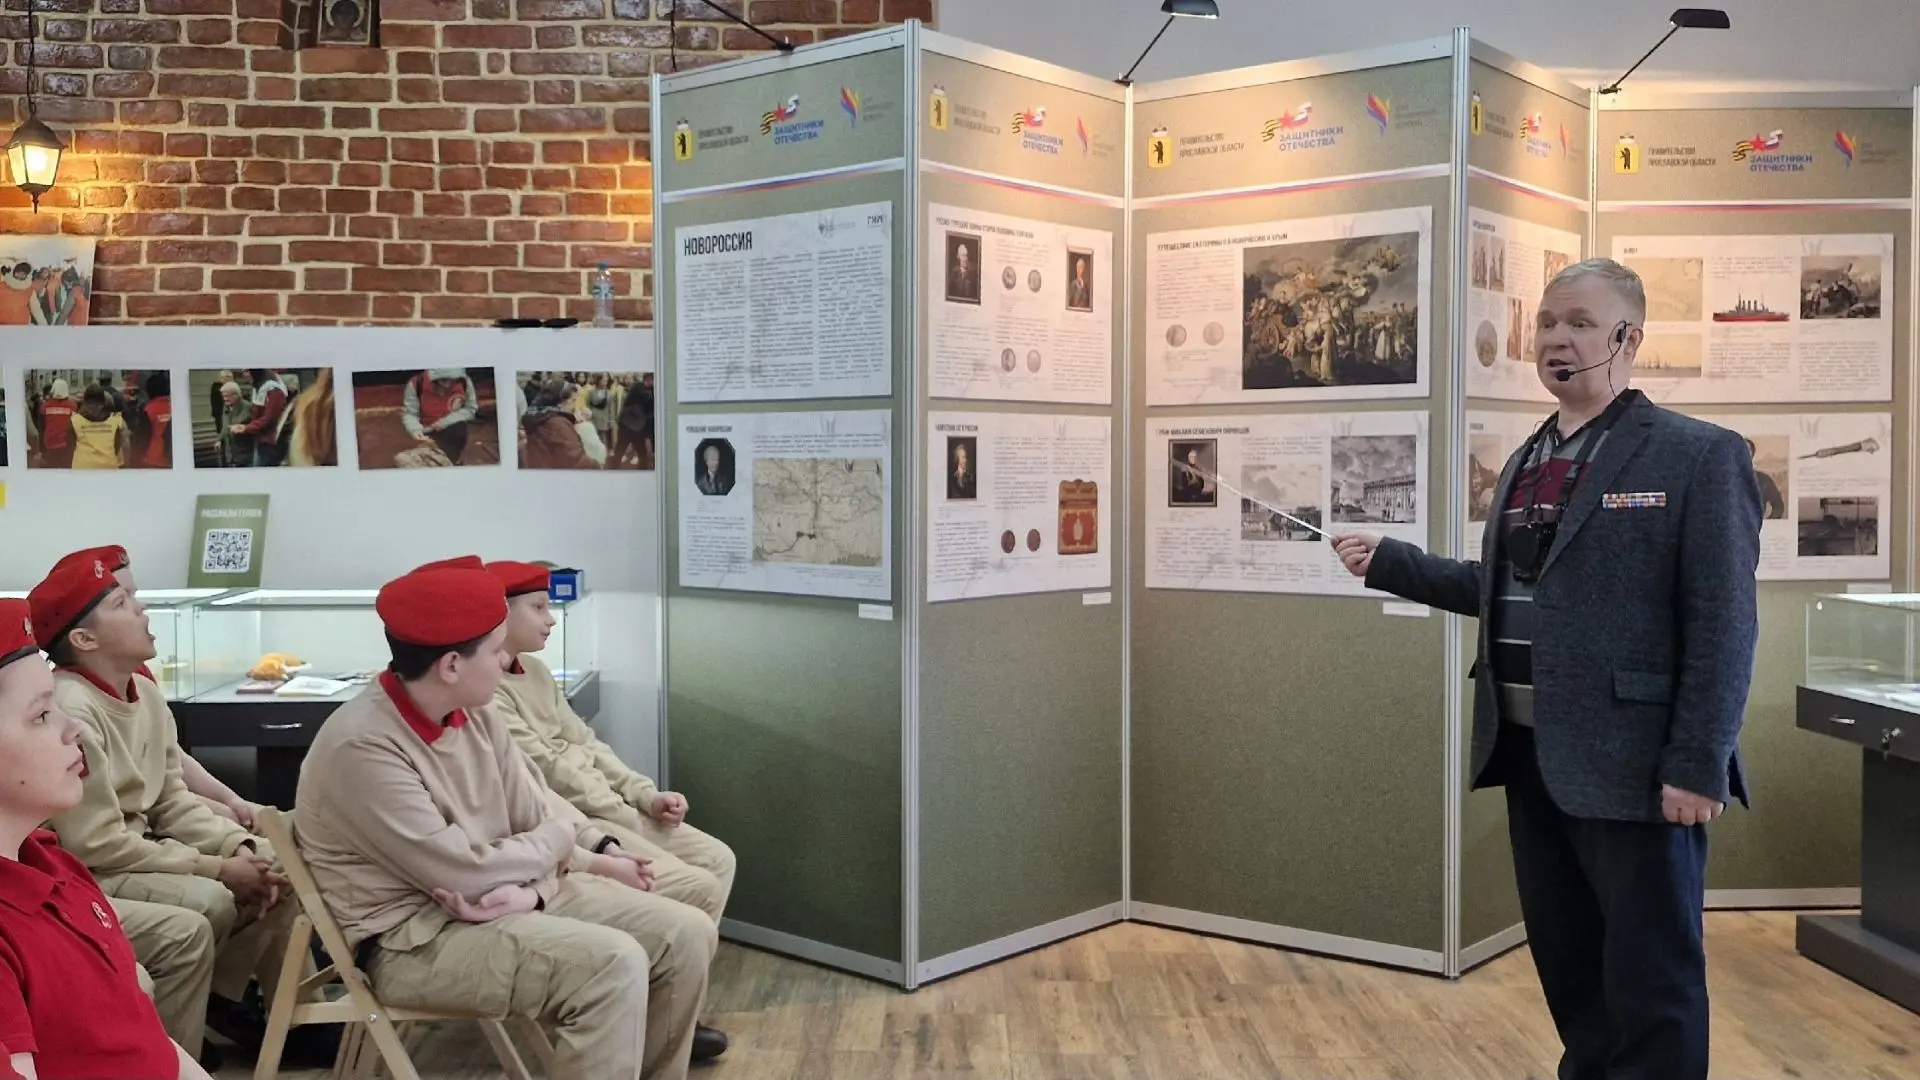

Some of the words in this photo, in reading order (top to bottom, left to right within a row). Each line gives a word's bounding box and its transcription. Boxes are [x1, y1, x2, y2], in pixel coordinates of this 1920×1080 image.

[774, 131, 819, 145] ОТЕЧЕСТВА
[1280, 126, 1344, 142] ЗАЩИТНИКИ
[1279, 137, 1336, 151] ОТЕЧЕСТВА
[1750, 154, 1813, 163] ЗАЩИТНИКИ
[1750, 163, 1805, 172] ОТЕЧЕСТВА
[684, 230, 753, 256] НОВОРОССИЯ
